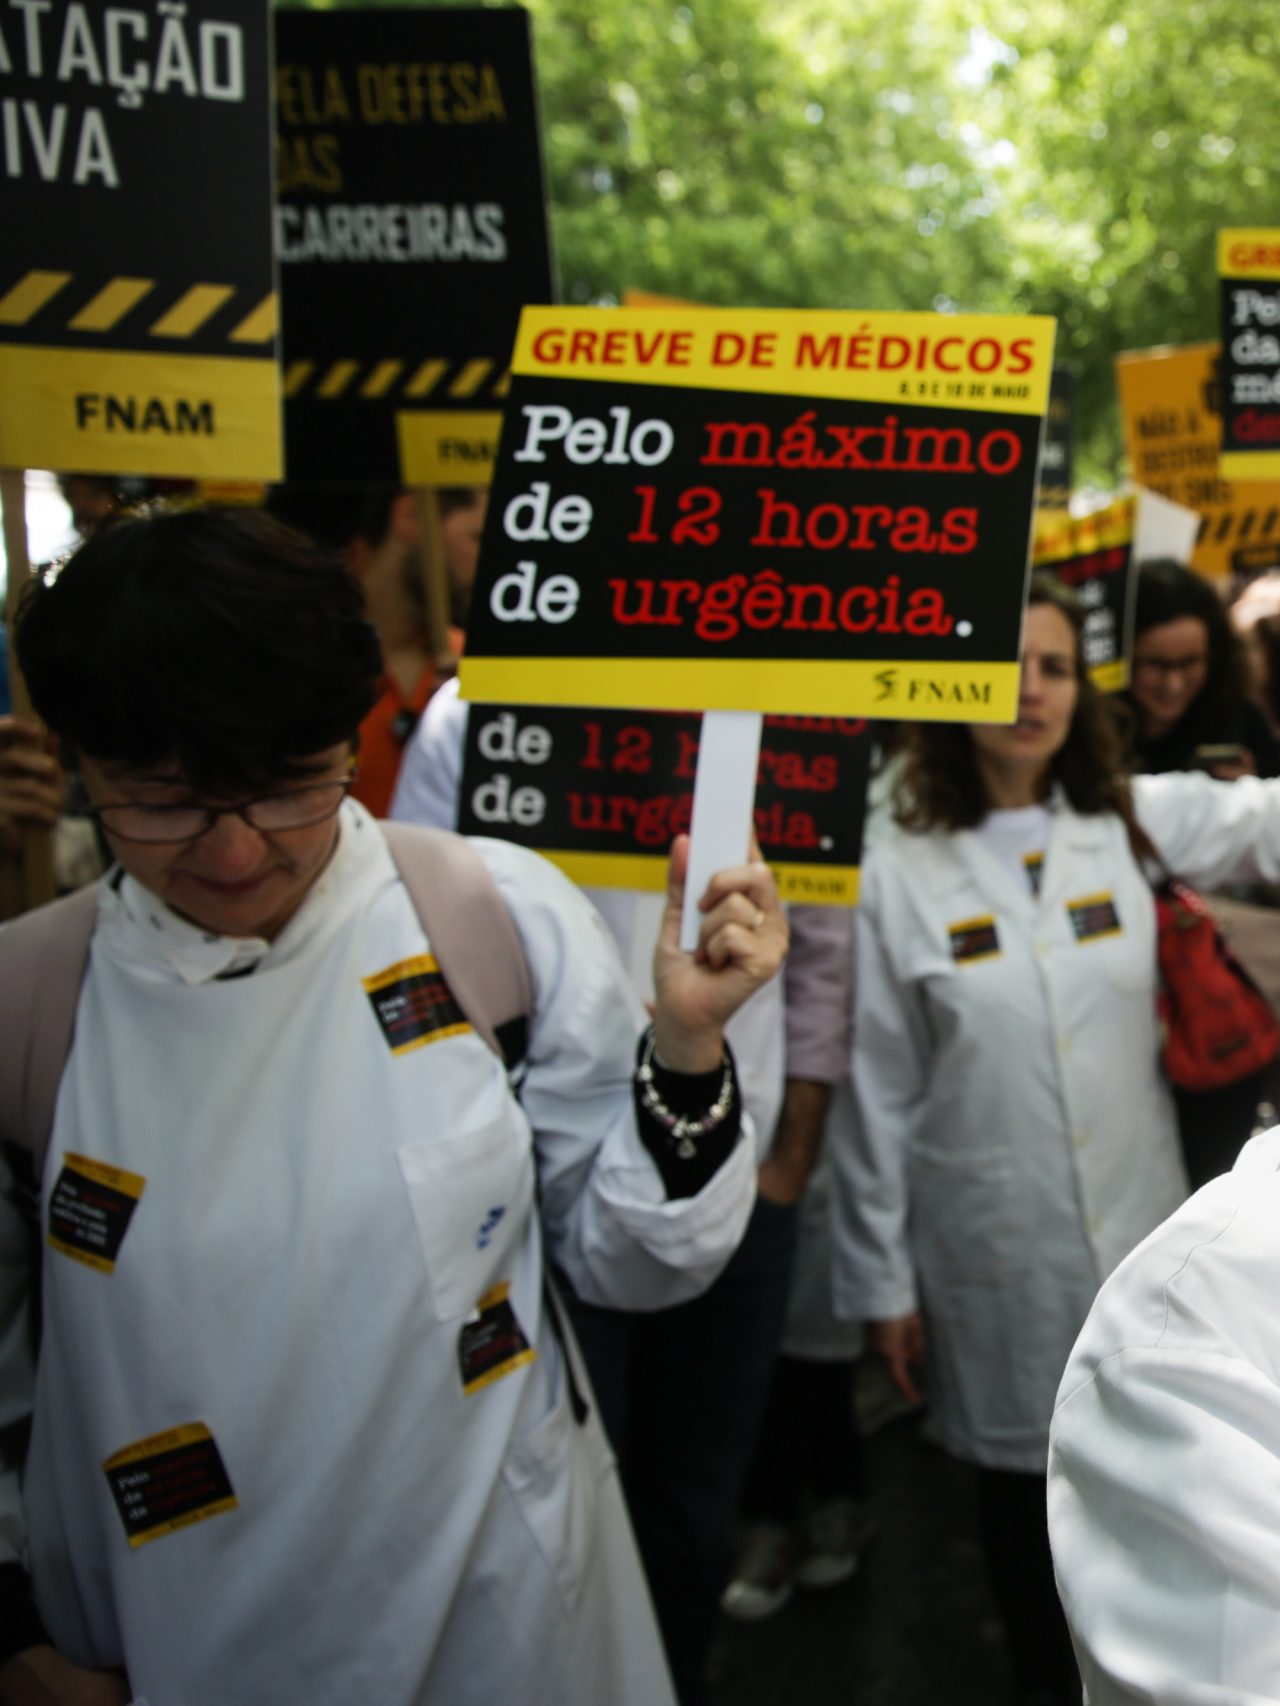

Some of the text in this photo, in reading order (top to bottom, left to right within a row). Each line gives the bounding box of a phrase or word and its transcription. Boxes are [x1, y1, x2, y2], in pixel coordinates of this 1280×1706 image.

[0, 0, 245, 109] TAÇÃO
[276, 62, 507, 125] ELA DEFESA
[272, 202, 507, 263] CARREIRAS
[531, 323, 1035, 375] GREVE DE MÉDICOS
[75, 394, 216, 436] FNAM
[513, 404, 675, 466] Pelo
[699, 411, 1023, 475] máximo
[502, 481, 594, 543] de
[627, 485, 723, 546] 12
[750, 490, 980, 555] horas
[489, 560, 974, 641] de urgência.
[906, 678, 993, 705] FNAM
[477, 712, 839, 792] de 12 hras
[471, 775, 546, 826] de
